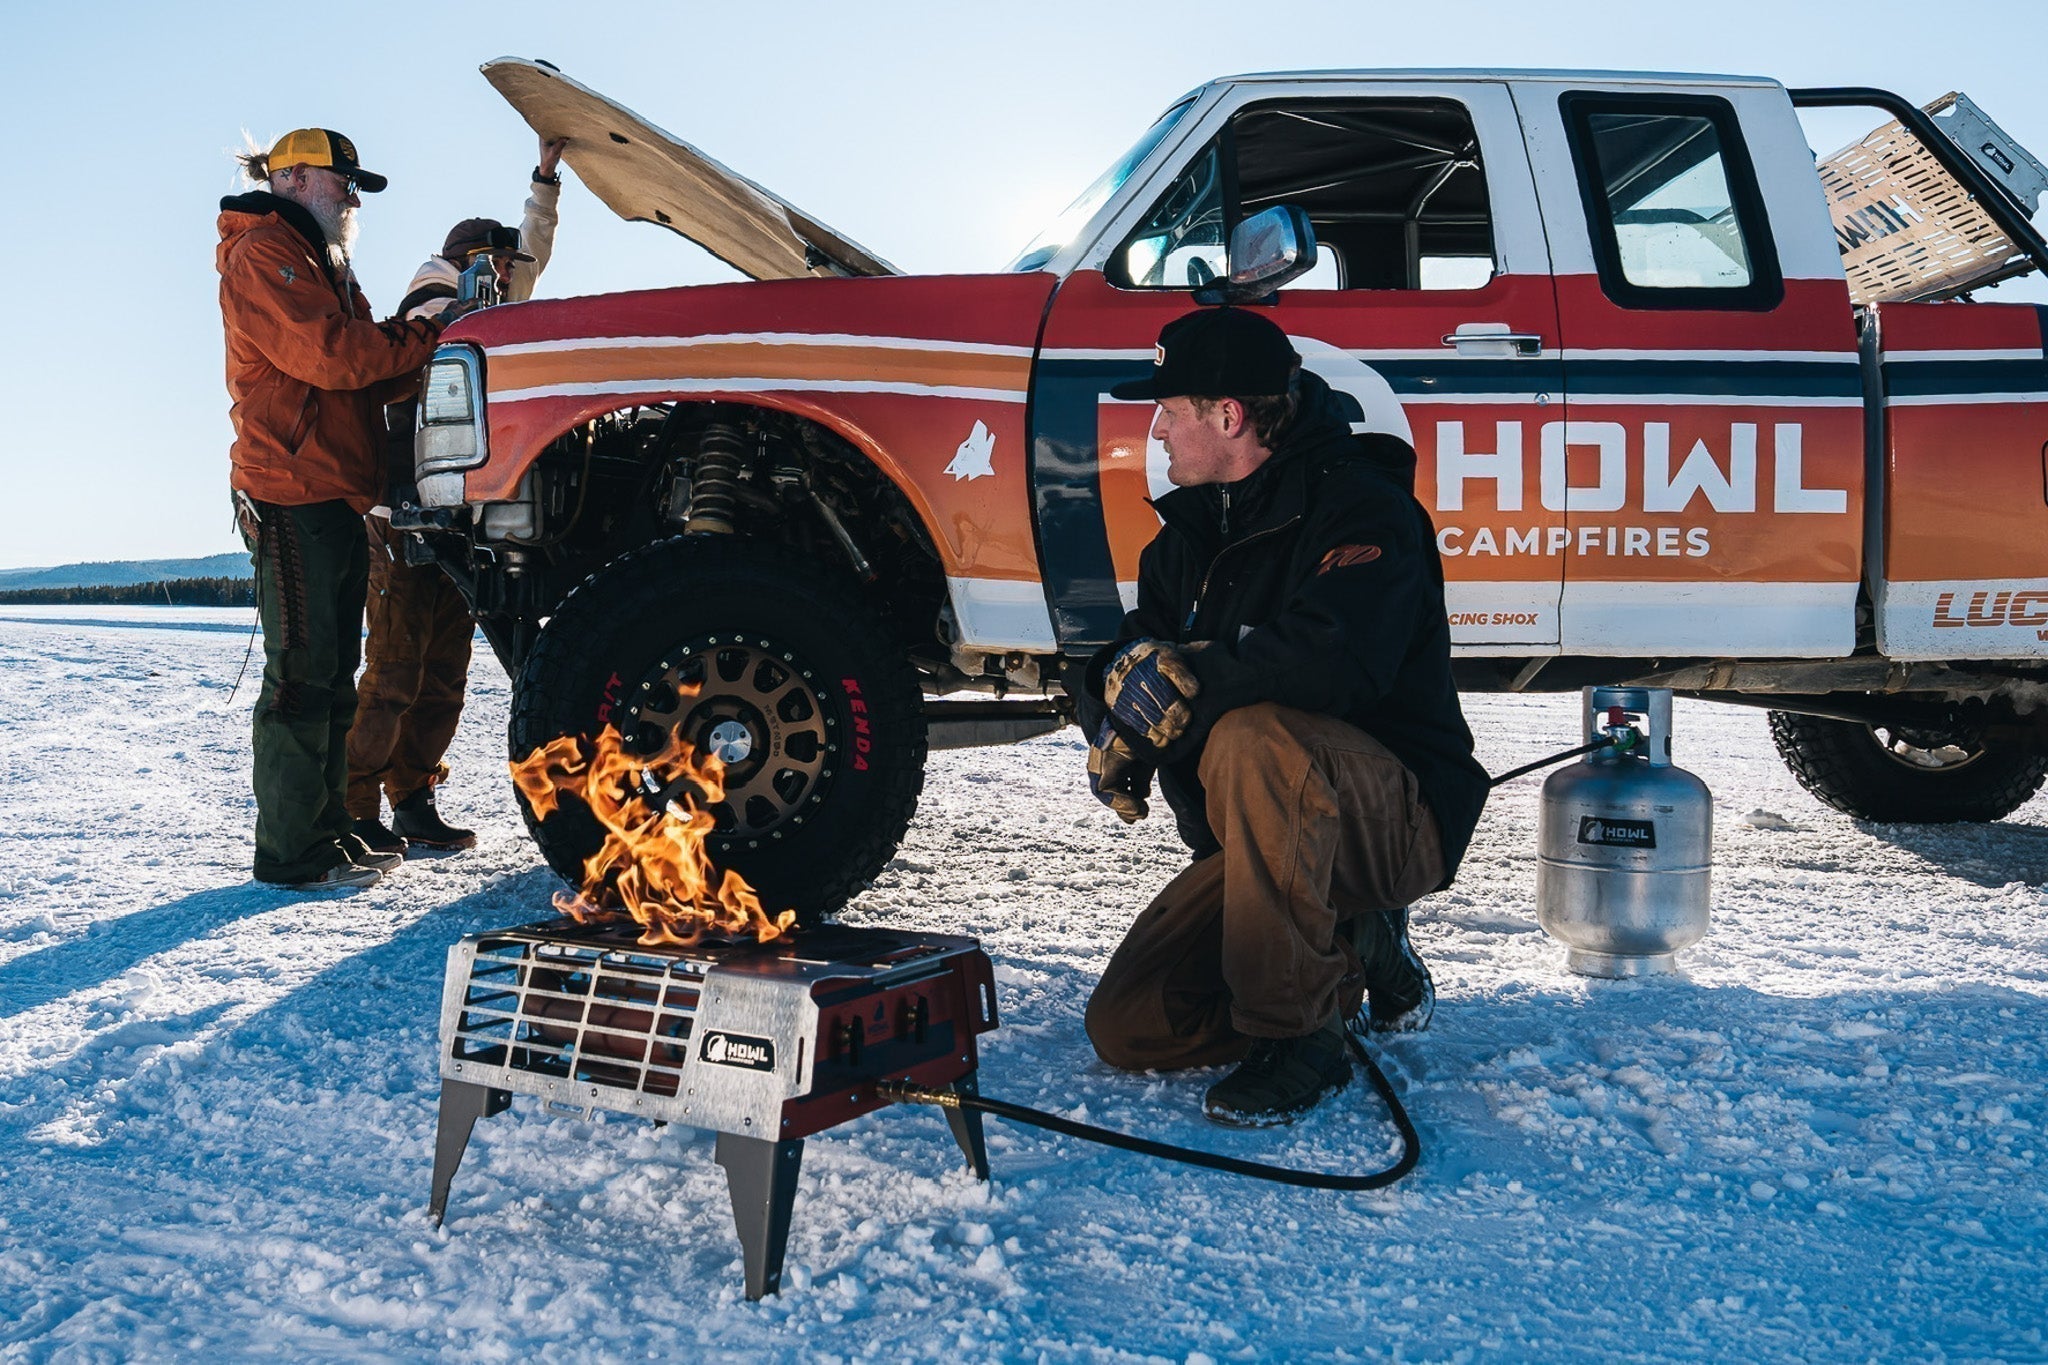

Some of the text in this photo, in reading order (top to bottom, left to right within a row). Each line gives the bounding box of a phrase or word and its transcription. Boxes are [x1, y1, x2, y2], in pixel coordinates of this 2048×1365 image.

[1436, 421, 1848, 514] HOWL
[1436, 526, 1711, 557] CAMPFIRES
[1491, 613, 1539, 626] SHOX
[841, 677, 871, 771] KENDA
[1606, 827, 1649, 839] HOWL
[728, 1042, 768, 1062] HOWL
